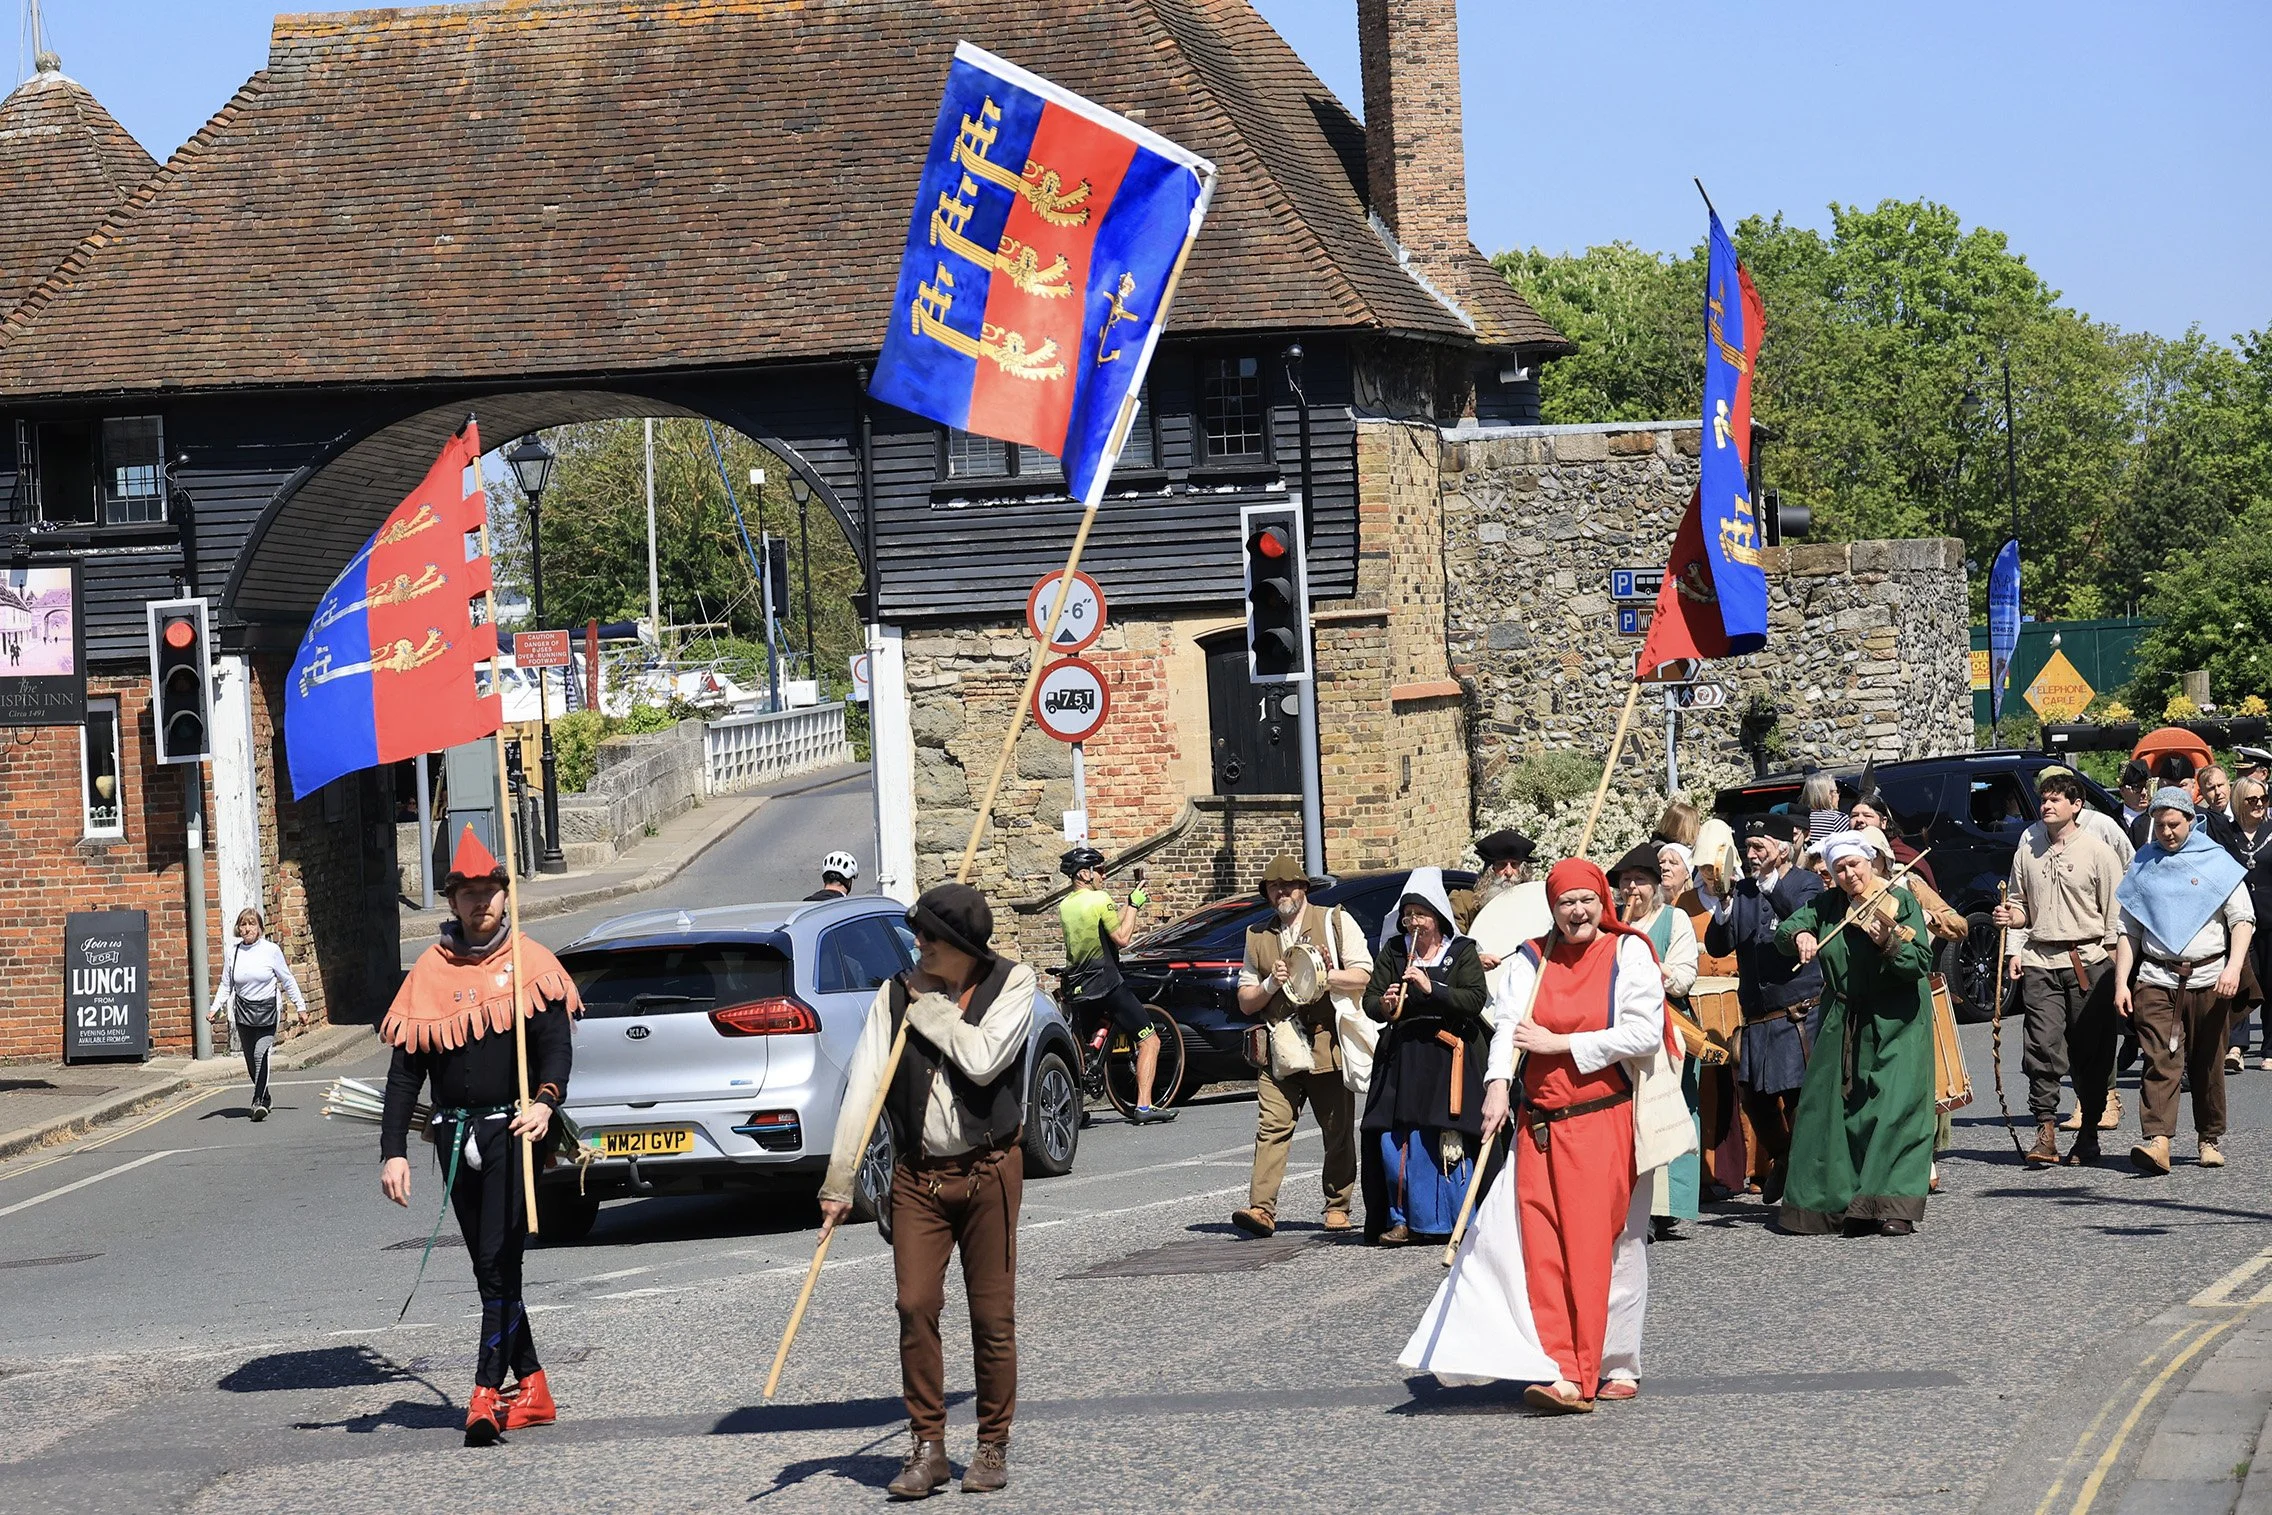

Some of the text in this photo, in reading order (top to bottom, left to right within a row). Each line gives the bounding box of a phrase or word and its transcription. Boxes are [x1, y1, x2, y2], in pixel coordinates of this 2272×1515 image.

[1617, 574, 1629, 593] P
[1623, 613, 1633, 630] P
[17, 677, 38, 693] The
[1, 692, 74, 706] ISPIN INN
[1061, 690, 1093, 707] 7.5T
[1258, 697, 1267, 722] 1
[80, 937, 107, 952] Join
[93, 954, 110, 962] FOR
[72, 966, 137, 996] LUNCH
[93, 996, 115, 1004] FROM
[76, 1004, 129, 1028] 12 PM
[106, 1028, 126, 1036] MENU
[106, 1035, 121, 1043] FROM
[629, 1028, 647, 1038] KIA
[606, 1130, 687, 1152] WM21 GVP
